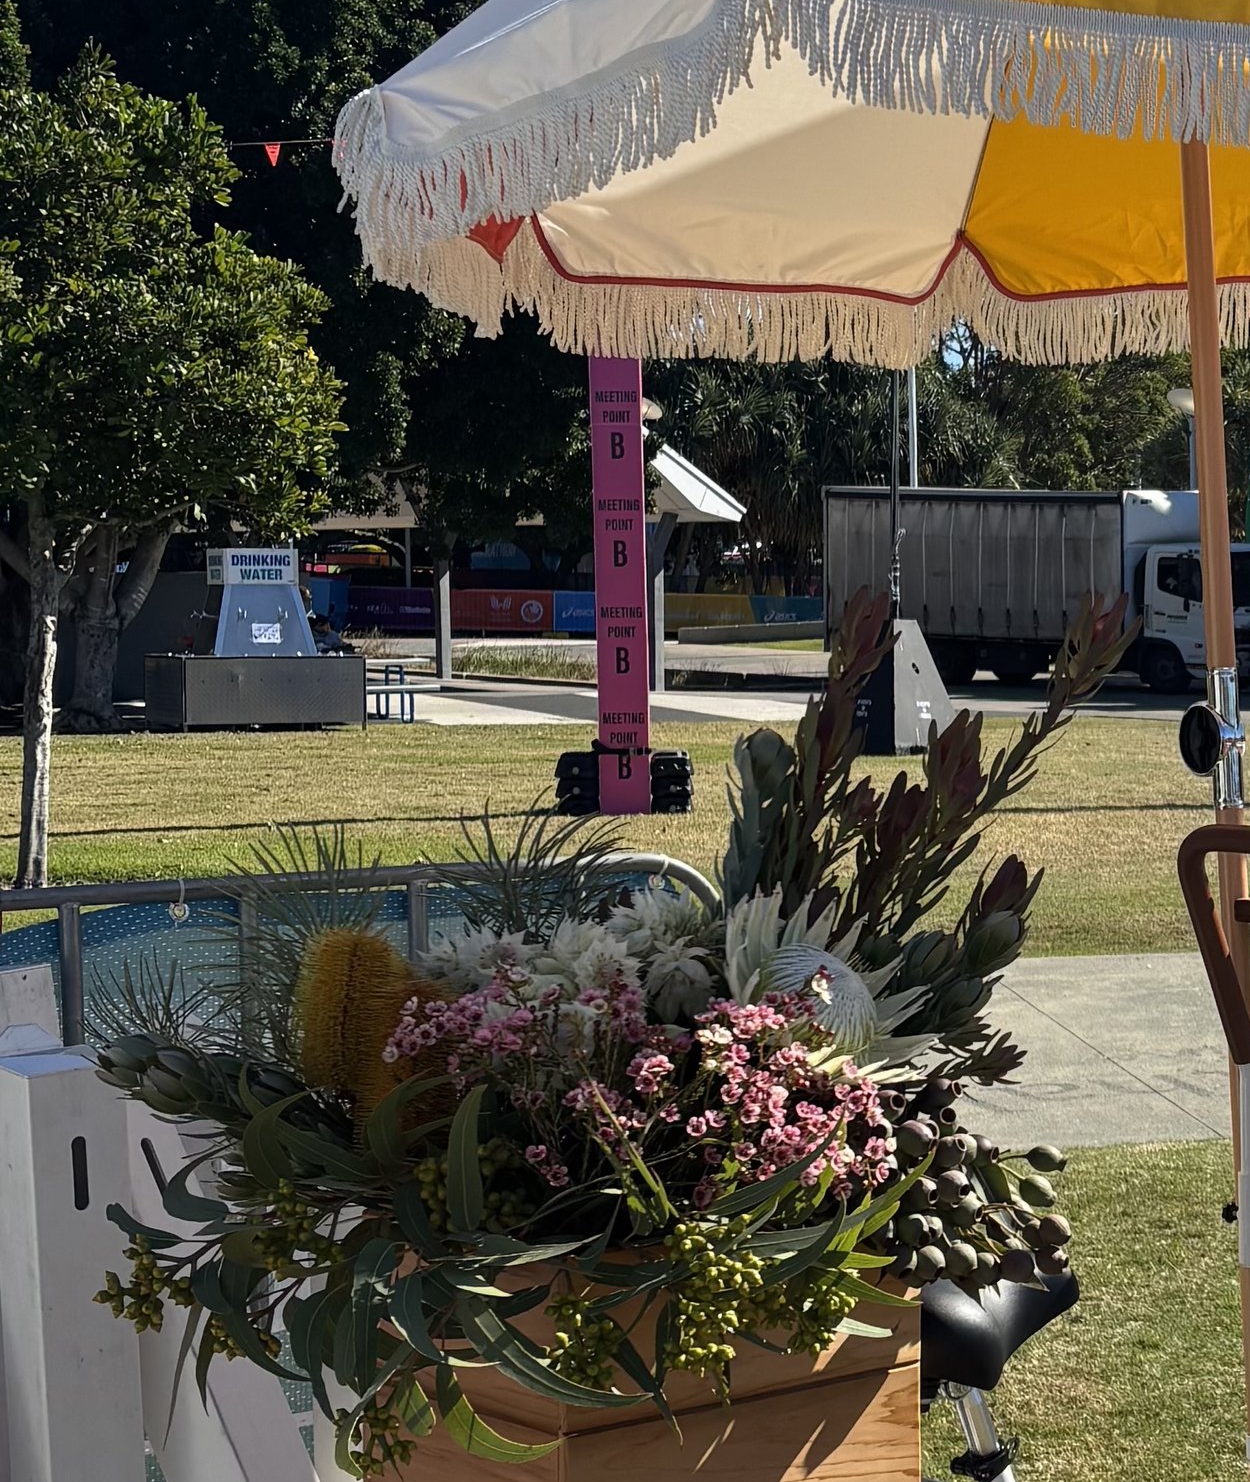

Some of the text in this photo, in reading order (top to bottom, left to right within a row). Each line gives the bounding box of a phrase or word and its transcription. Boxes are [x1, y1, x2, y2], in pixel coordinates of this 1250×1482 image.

[595, 391, 637, 403] MEETING
[602, 411, 631, 423] POINT
[610, 432, 625, 460] B
[598, 500, 640, 511] MEETING
[605, 519, 634, 531] POINT
[613, 540, 628, 568] B
[231, 554, 291, 567] DRINKING
[240, 568, 284, 581] WATER
[600, 607, 643, 618] MEETING
[607, 626, 637, 638] POINT
[616, 646, 630, 674] B
[603, 712, 645, 724] MEETING
[610, 732, 639, 744] POINT
[618, 753, 632, 780] B
